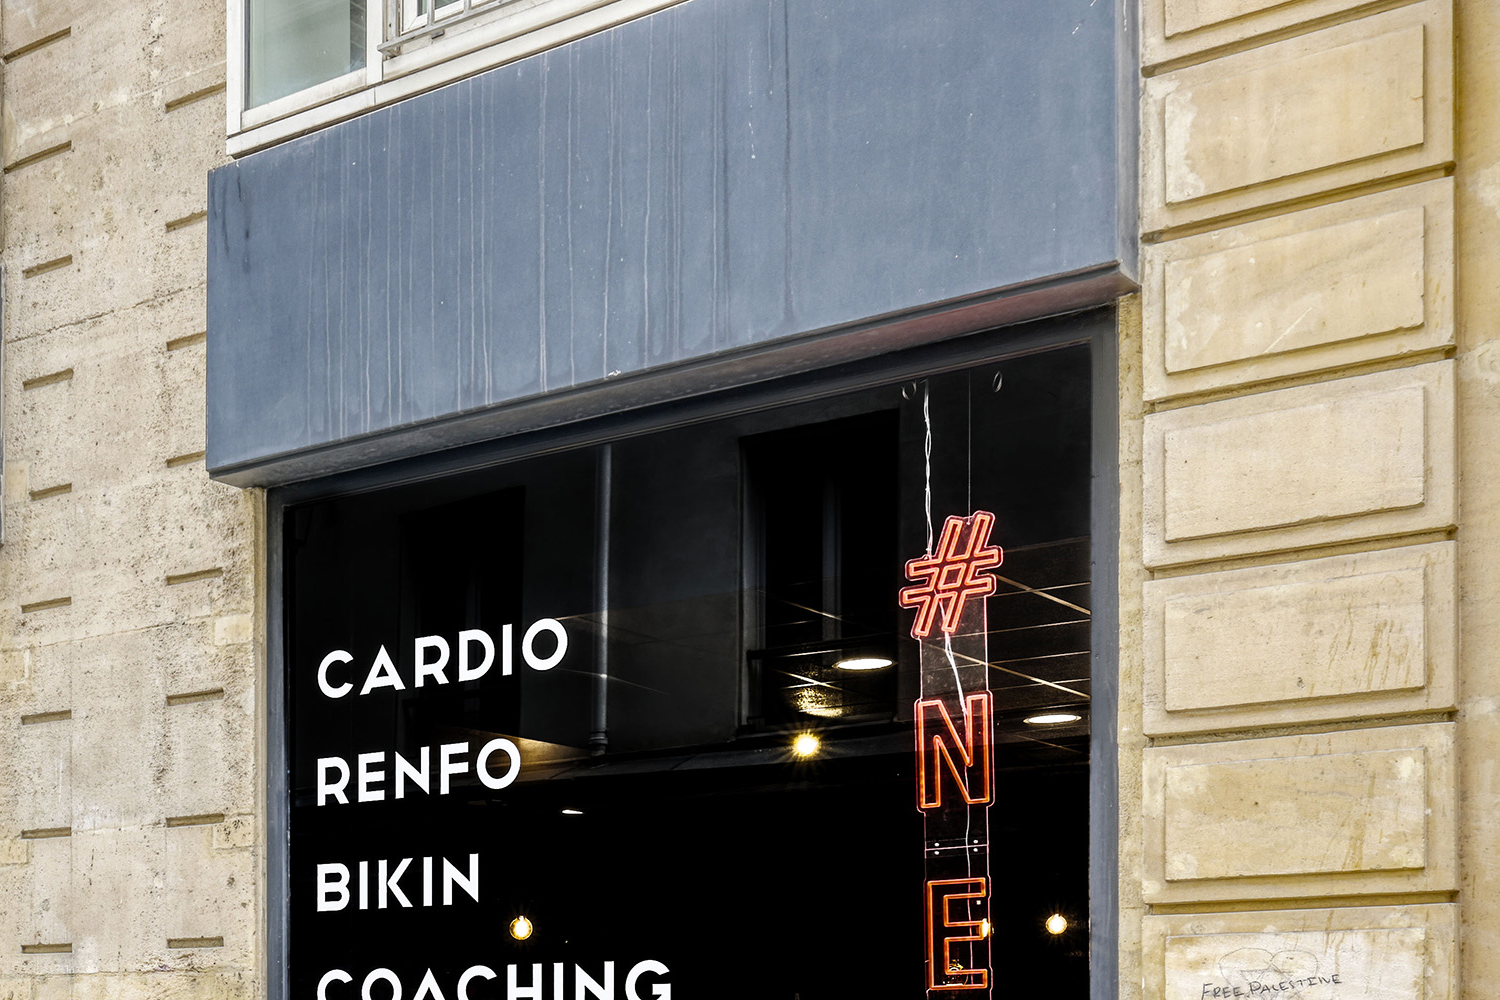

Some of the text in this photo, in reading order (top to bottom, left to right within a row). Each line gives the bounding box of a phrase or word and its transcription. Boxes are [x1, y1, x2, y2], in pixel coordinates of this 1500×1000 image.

[317, 618, 568, 699] CARDIO
[317, 738, 522, 807] RENFO
[316, 853, 480, 912] BIKIN
[1249, 974, 1342, 995] PALESTINE
